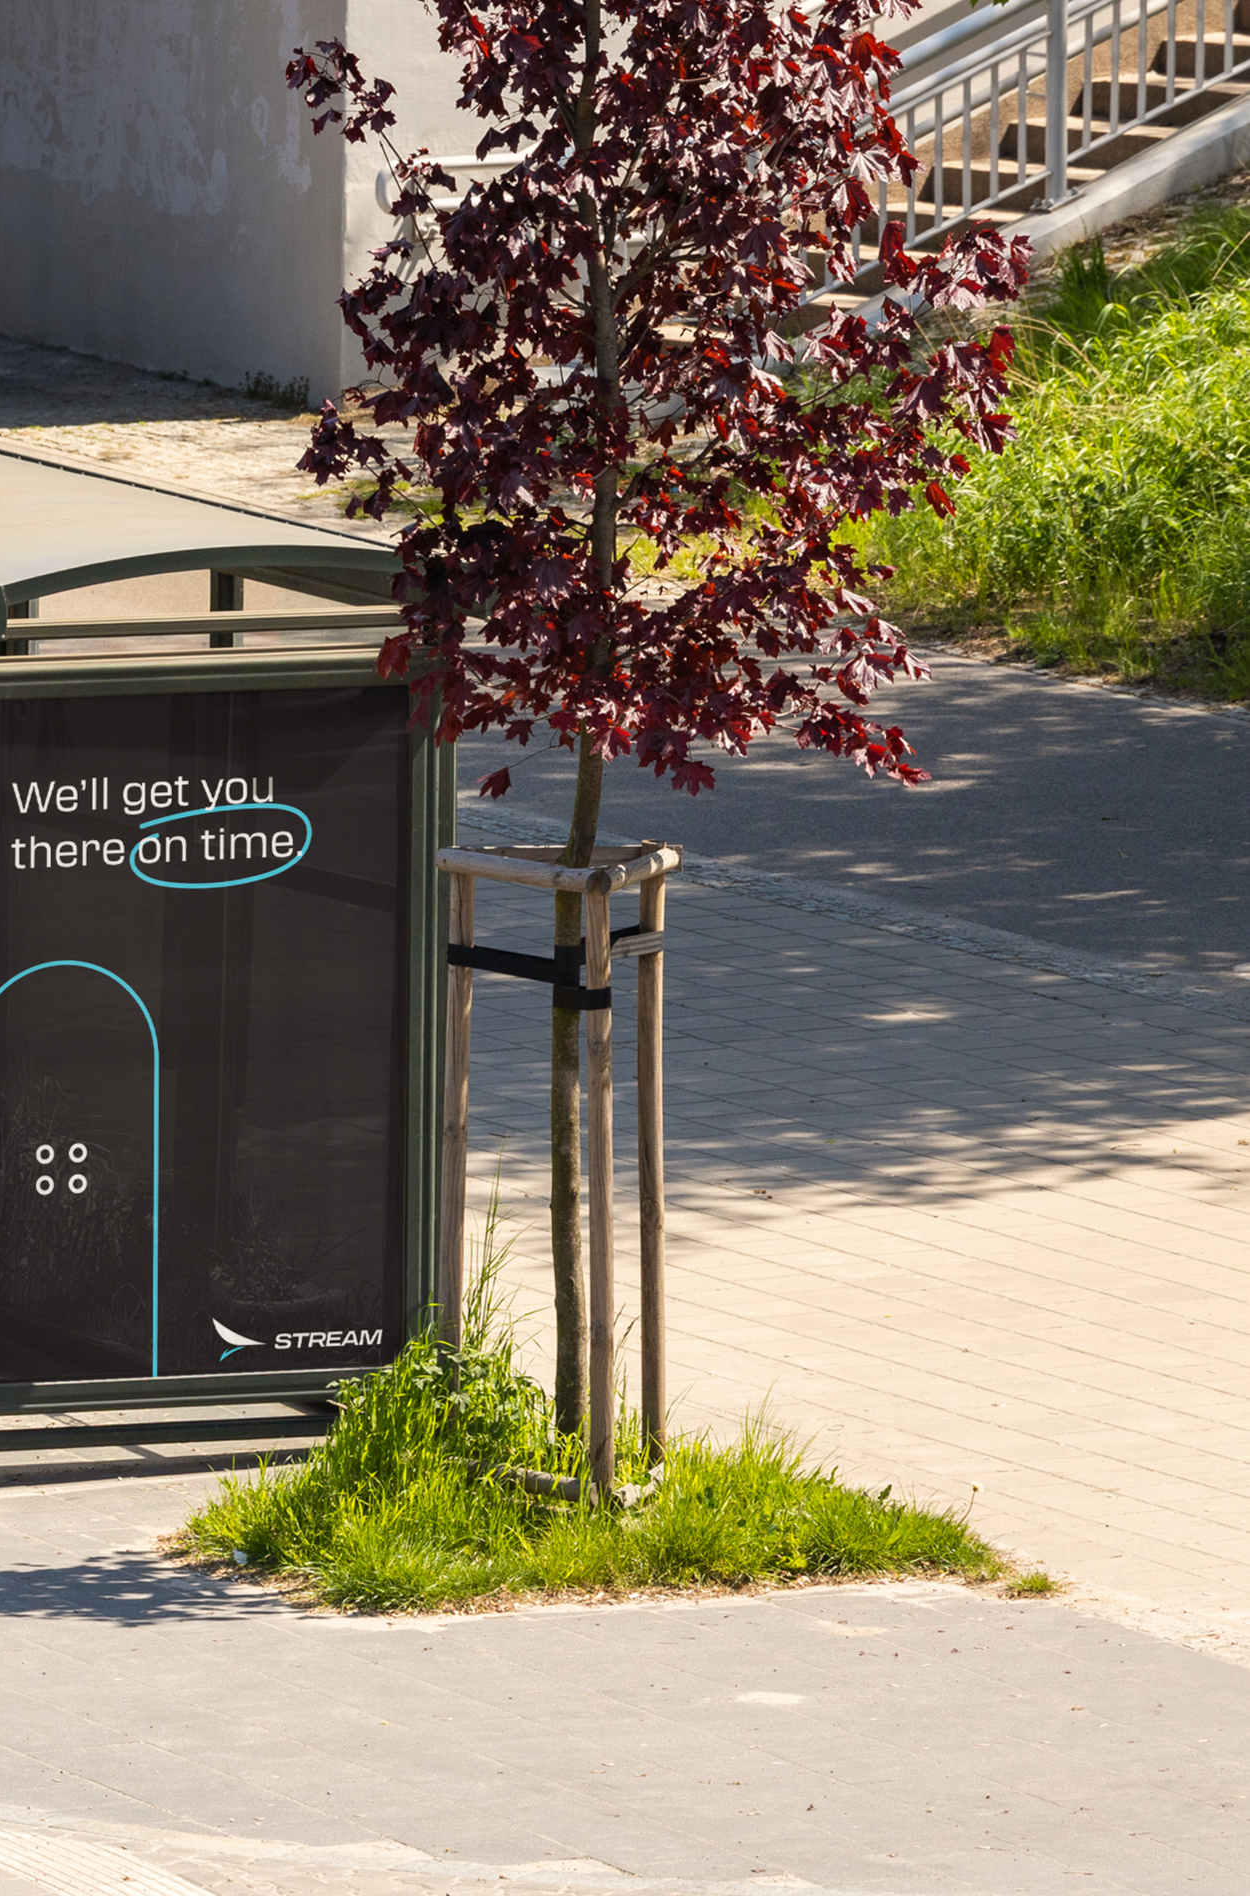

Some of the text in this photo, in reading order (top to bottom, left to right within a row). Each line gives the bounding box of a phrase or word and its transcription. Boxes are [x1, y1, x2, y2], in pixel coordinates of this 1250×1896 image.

[11, 775, 275, 815] We’ll get you
[10, 827, 304, 869] there on time.
[274, 1328, 384, 1350] STREAM
